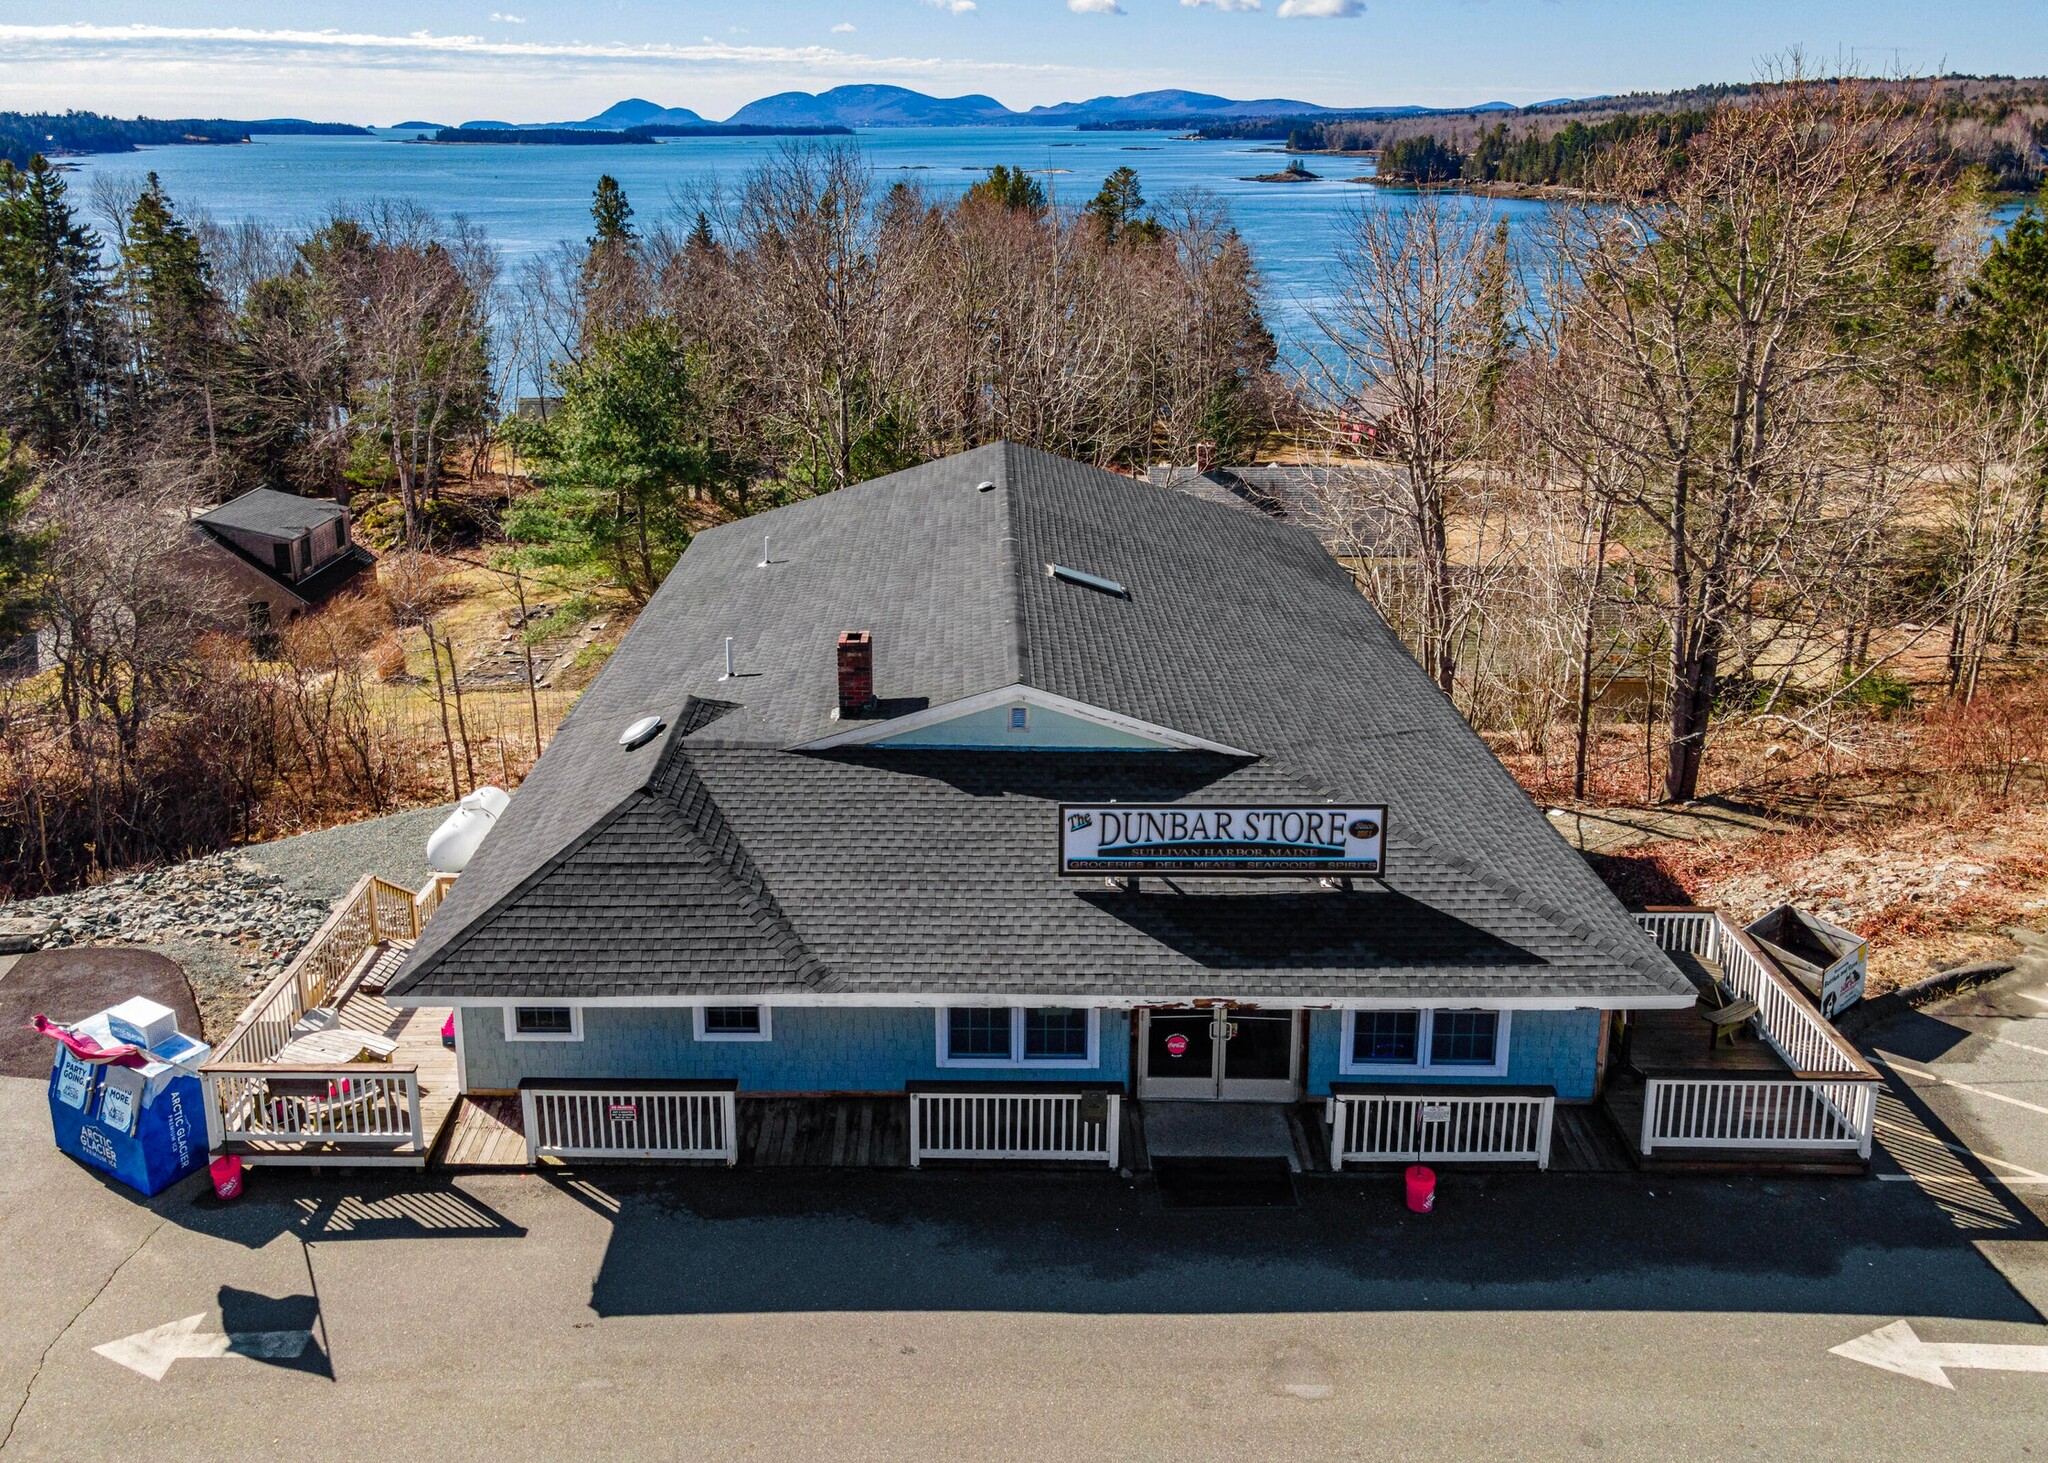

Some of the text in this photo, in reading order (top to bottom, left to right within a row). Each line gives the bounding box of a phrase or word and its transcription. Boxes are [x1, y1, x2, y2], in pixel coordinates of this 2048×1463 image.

[1067, 812, 1092, 831] The
[1098, 811, 1347, 848] DUNBAR STORE
[1131, 848, 1319, 858] SULLIVAN HARBOR, MAINE
[1070, 861, 1377, 870] GROCERIES DELI MEATS SEAFOODS SPIRITS
[65, 1061, 88, 1076] PARTY
[63, 1070, 86, 1087] GOING.
[109, 1089, 131, 1106] MORE.
[81, 1125, 113, 1150] ARCTIC
[168, 1114, 176, 1142] PREMIUM
[171, 1092, 190, 1169] ARCTIC GLACIER
[80, 1134, 118, 1162] GLACIER
